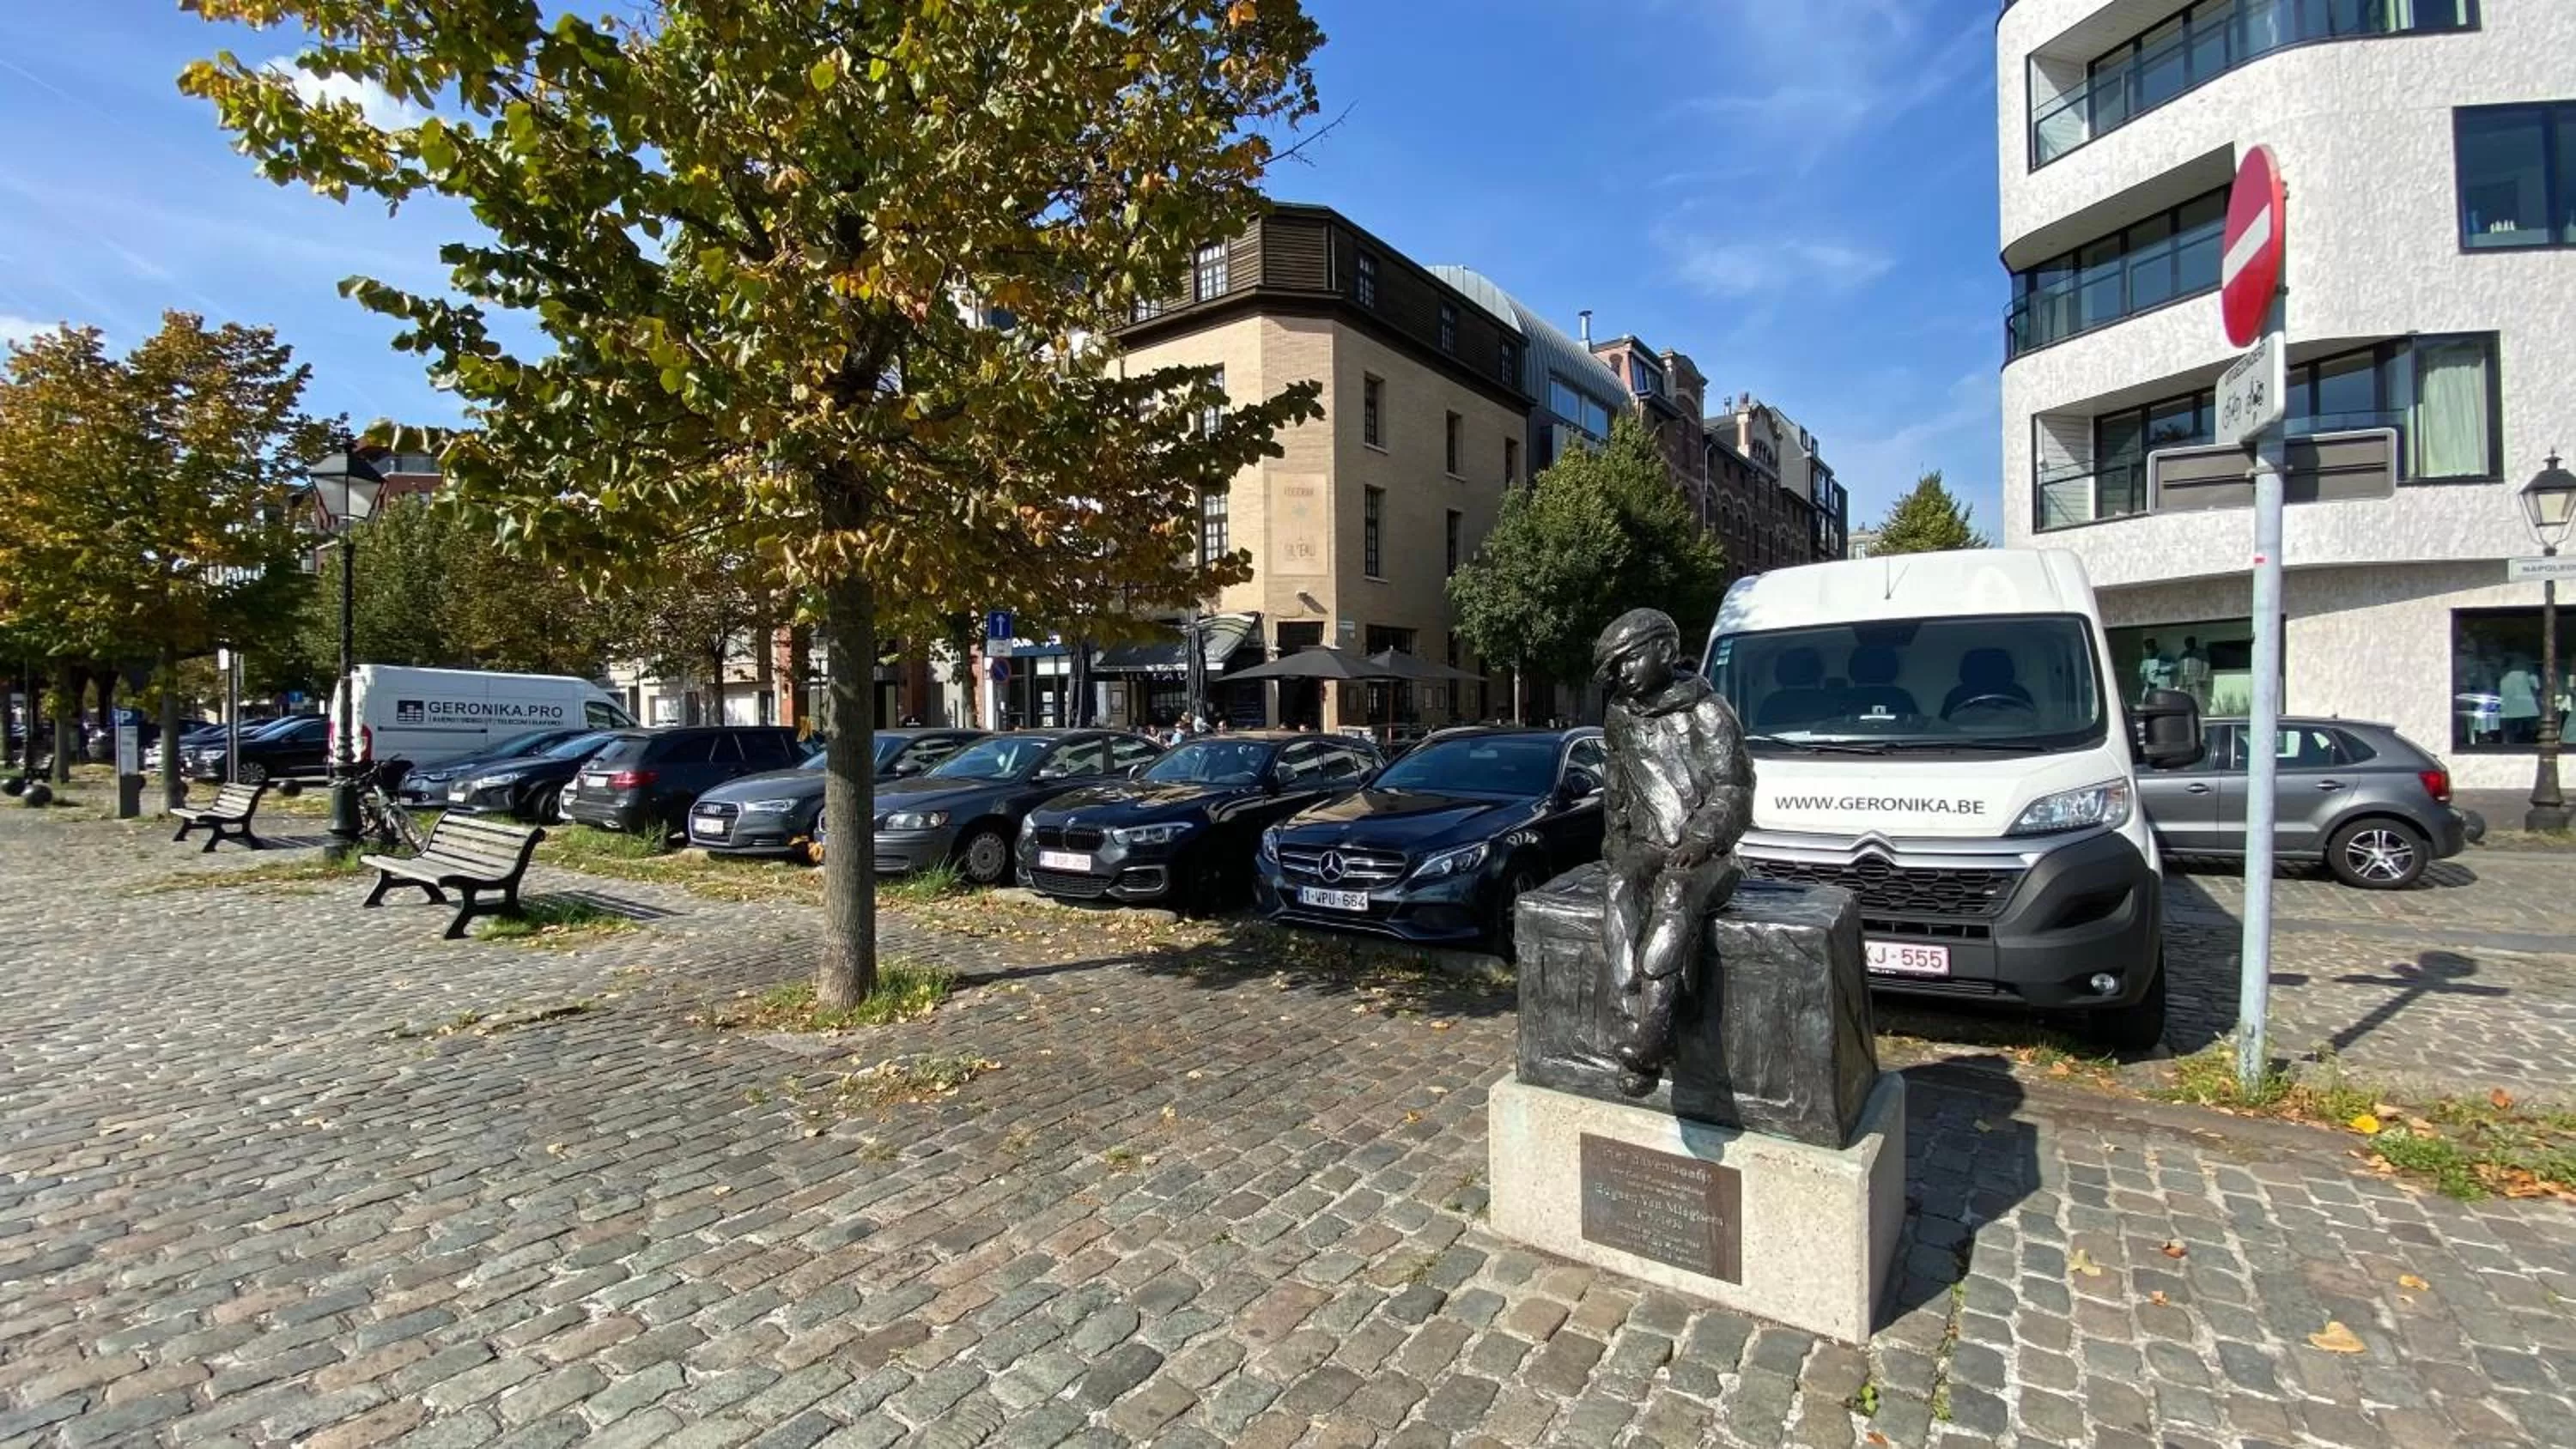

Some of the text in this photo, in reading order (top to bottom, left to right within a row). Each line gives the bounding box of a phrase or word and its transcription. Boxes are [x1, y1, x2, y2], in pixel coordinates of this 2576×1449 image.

[119, 710, 133, 724] P
[428, 700, 563, 718] GERONIKA.PRO
[1774, 796, 1986, 815] WWW.GERONIKA.BE
